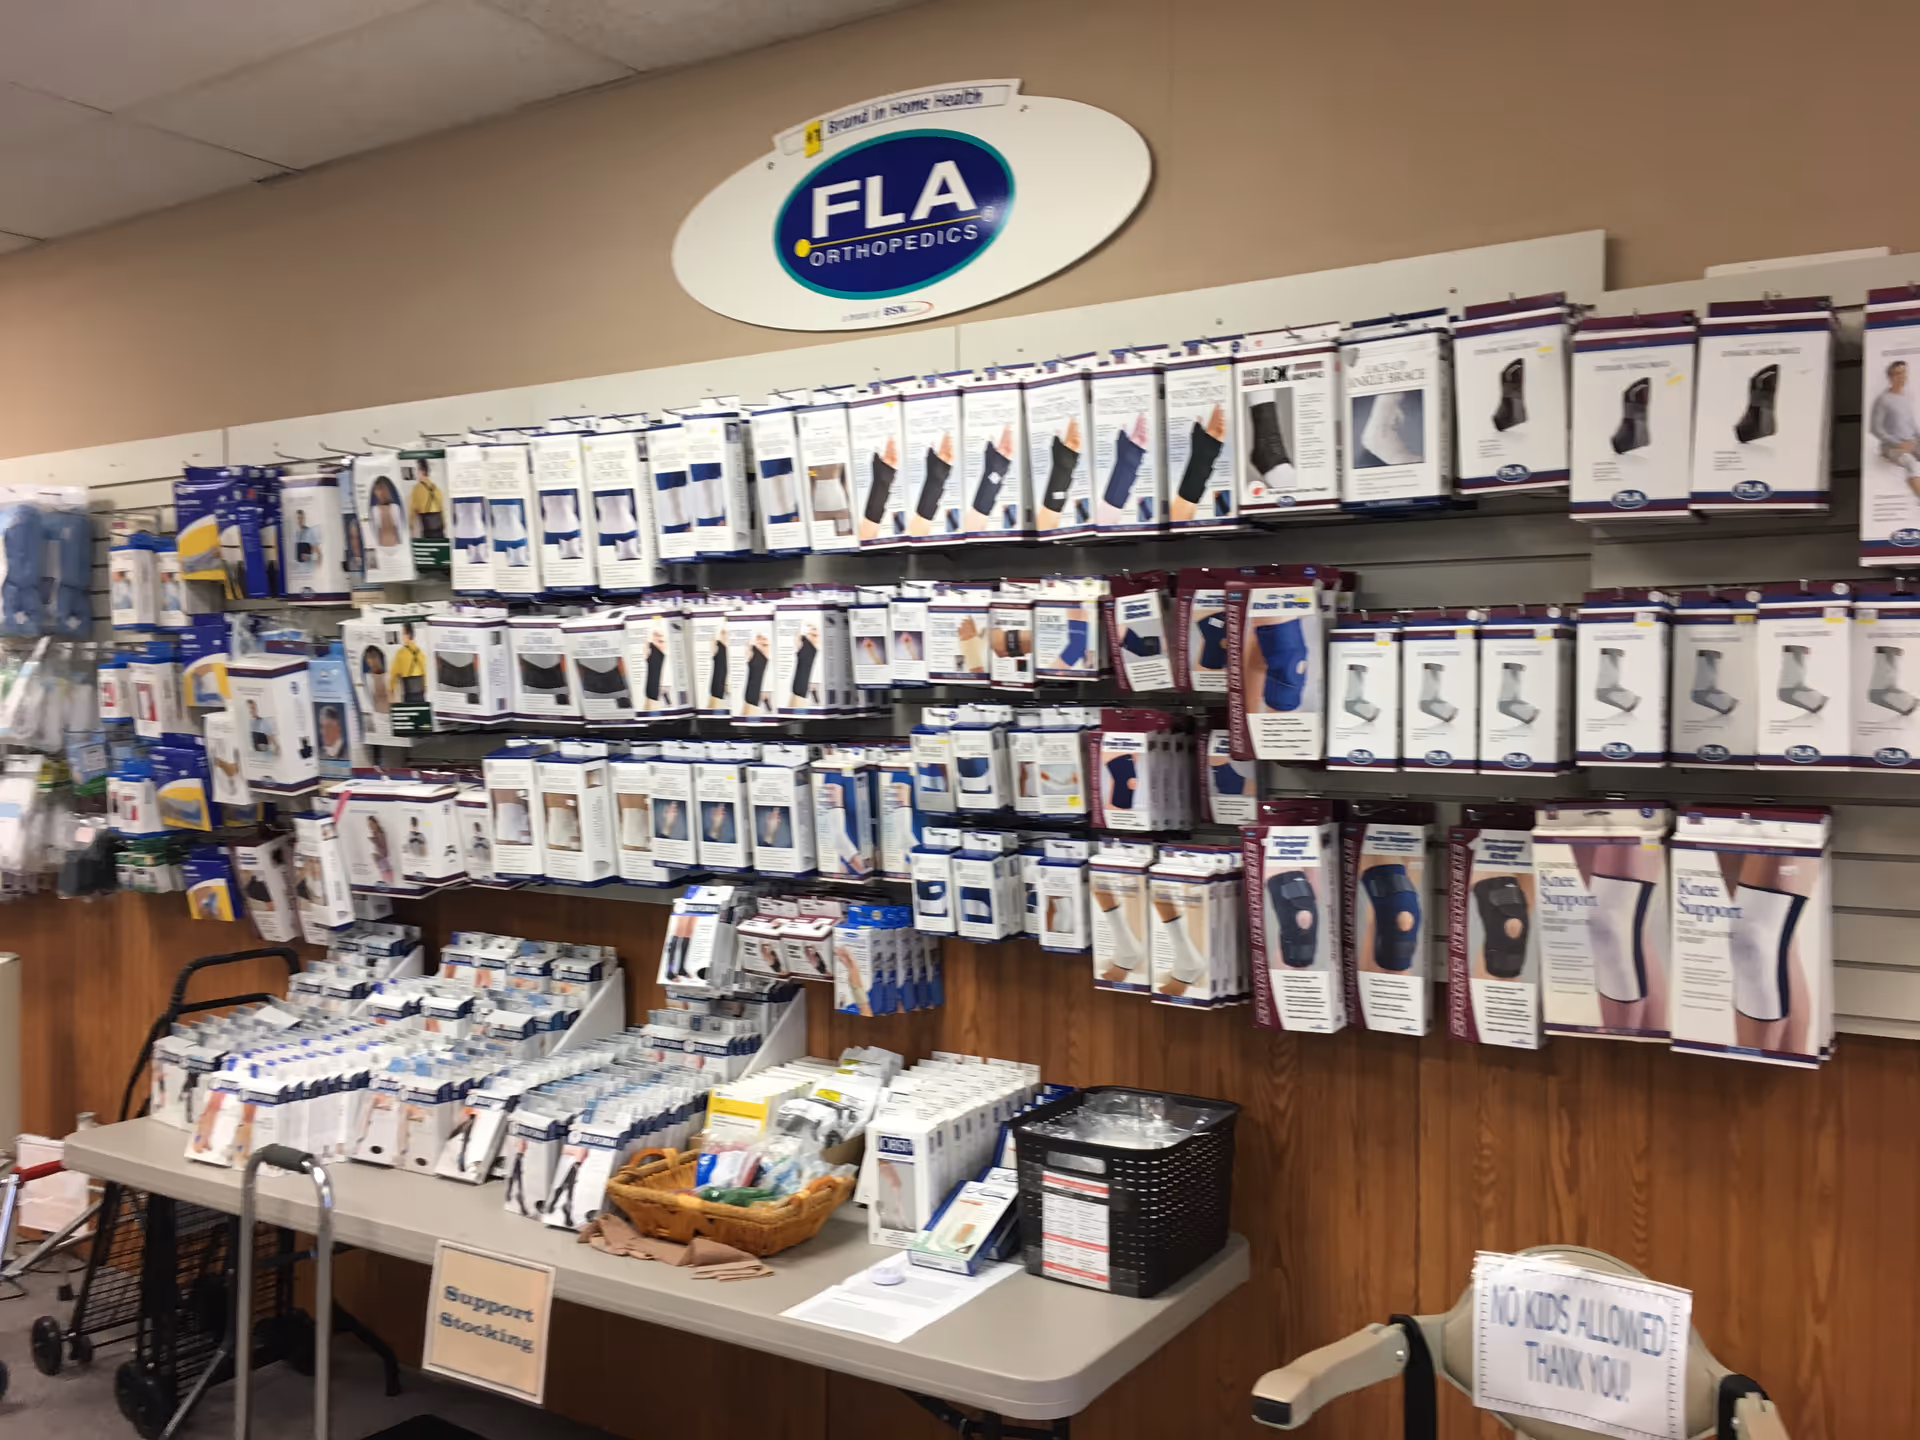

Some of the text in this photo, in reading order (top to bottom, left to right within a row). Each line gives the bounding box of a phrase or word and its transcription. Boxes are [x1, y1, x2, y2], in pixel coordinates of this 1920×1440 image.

[828, 110, 870, 133] Brand
[872, 104, 888, 121] in
[891, 98, 930, 116] Home
[934, 89, 983, 107] Health
[812, 160, 977, 239] FLA
[809, 224, 978, 267] ORTHOPEDICS
[1539, 870, 1576, 887] Knee
[1540, 888, 1598, 911] Support
[1678, 877, 1719, 896] Knee
[1677, 896, 1744, 923] Support
[444, 1285, 534, 1322] Support
[1490, 1284, 1667, 1357] NO KIDS ALLOWED
[440, 1311, 535, 1354] Stocking
[1524, 1340, 1584, 1392] THANK
